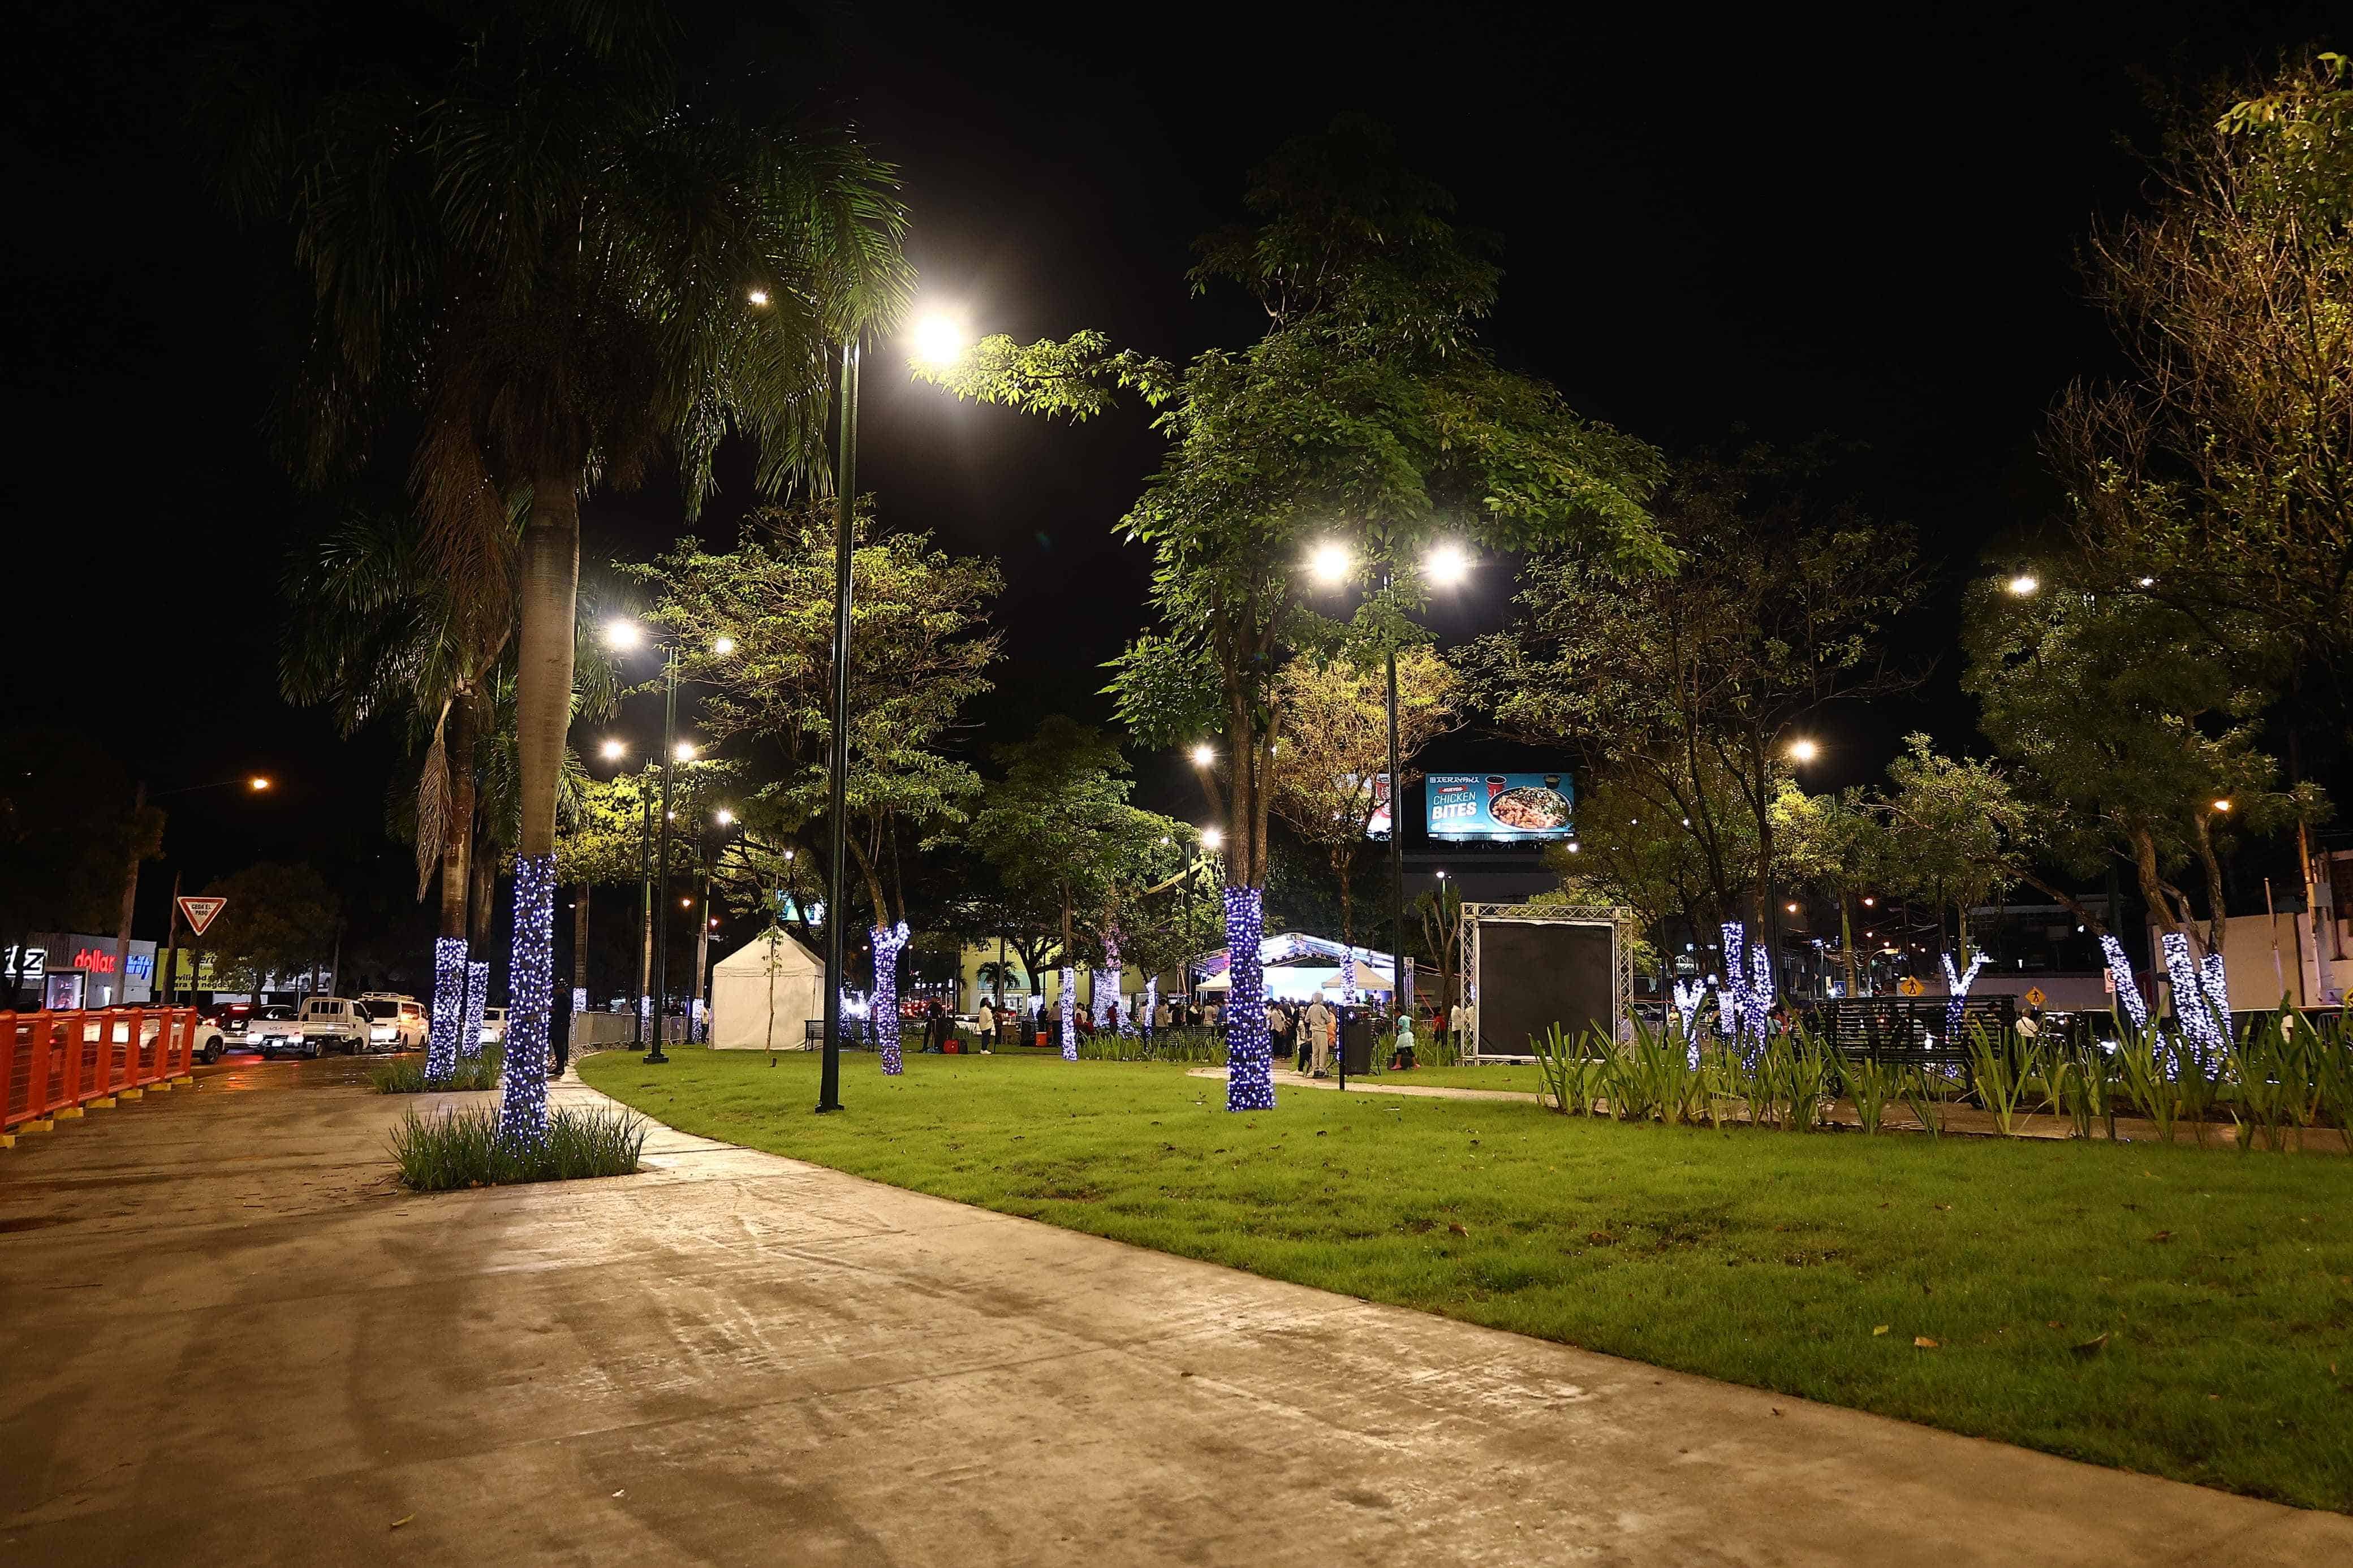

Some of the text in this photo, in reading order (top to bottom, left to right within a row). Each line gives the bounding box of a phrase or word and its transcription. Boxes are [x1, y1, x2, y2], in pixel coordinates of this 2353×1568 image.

[1433, 791, 1476, 805] CHICKEN
[1431, 801, 1477, 820] BITES
[74, 948, 117, 973] dollar
